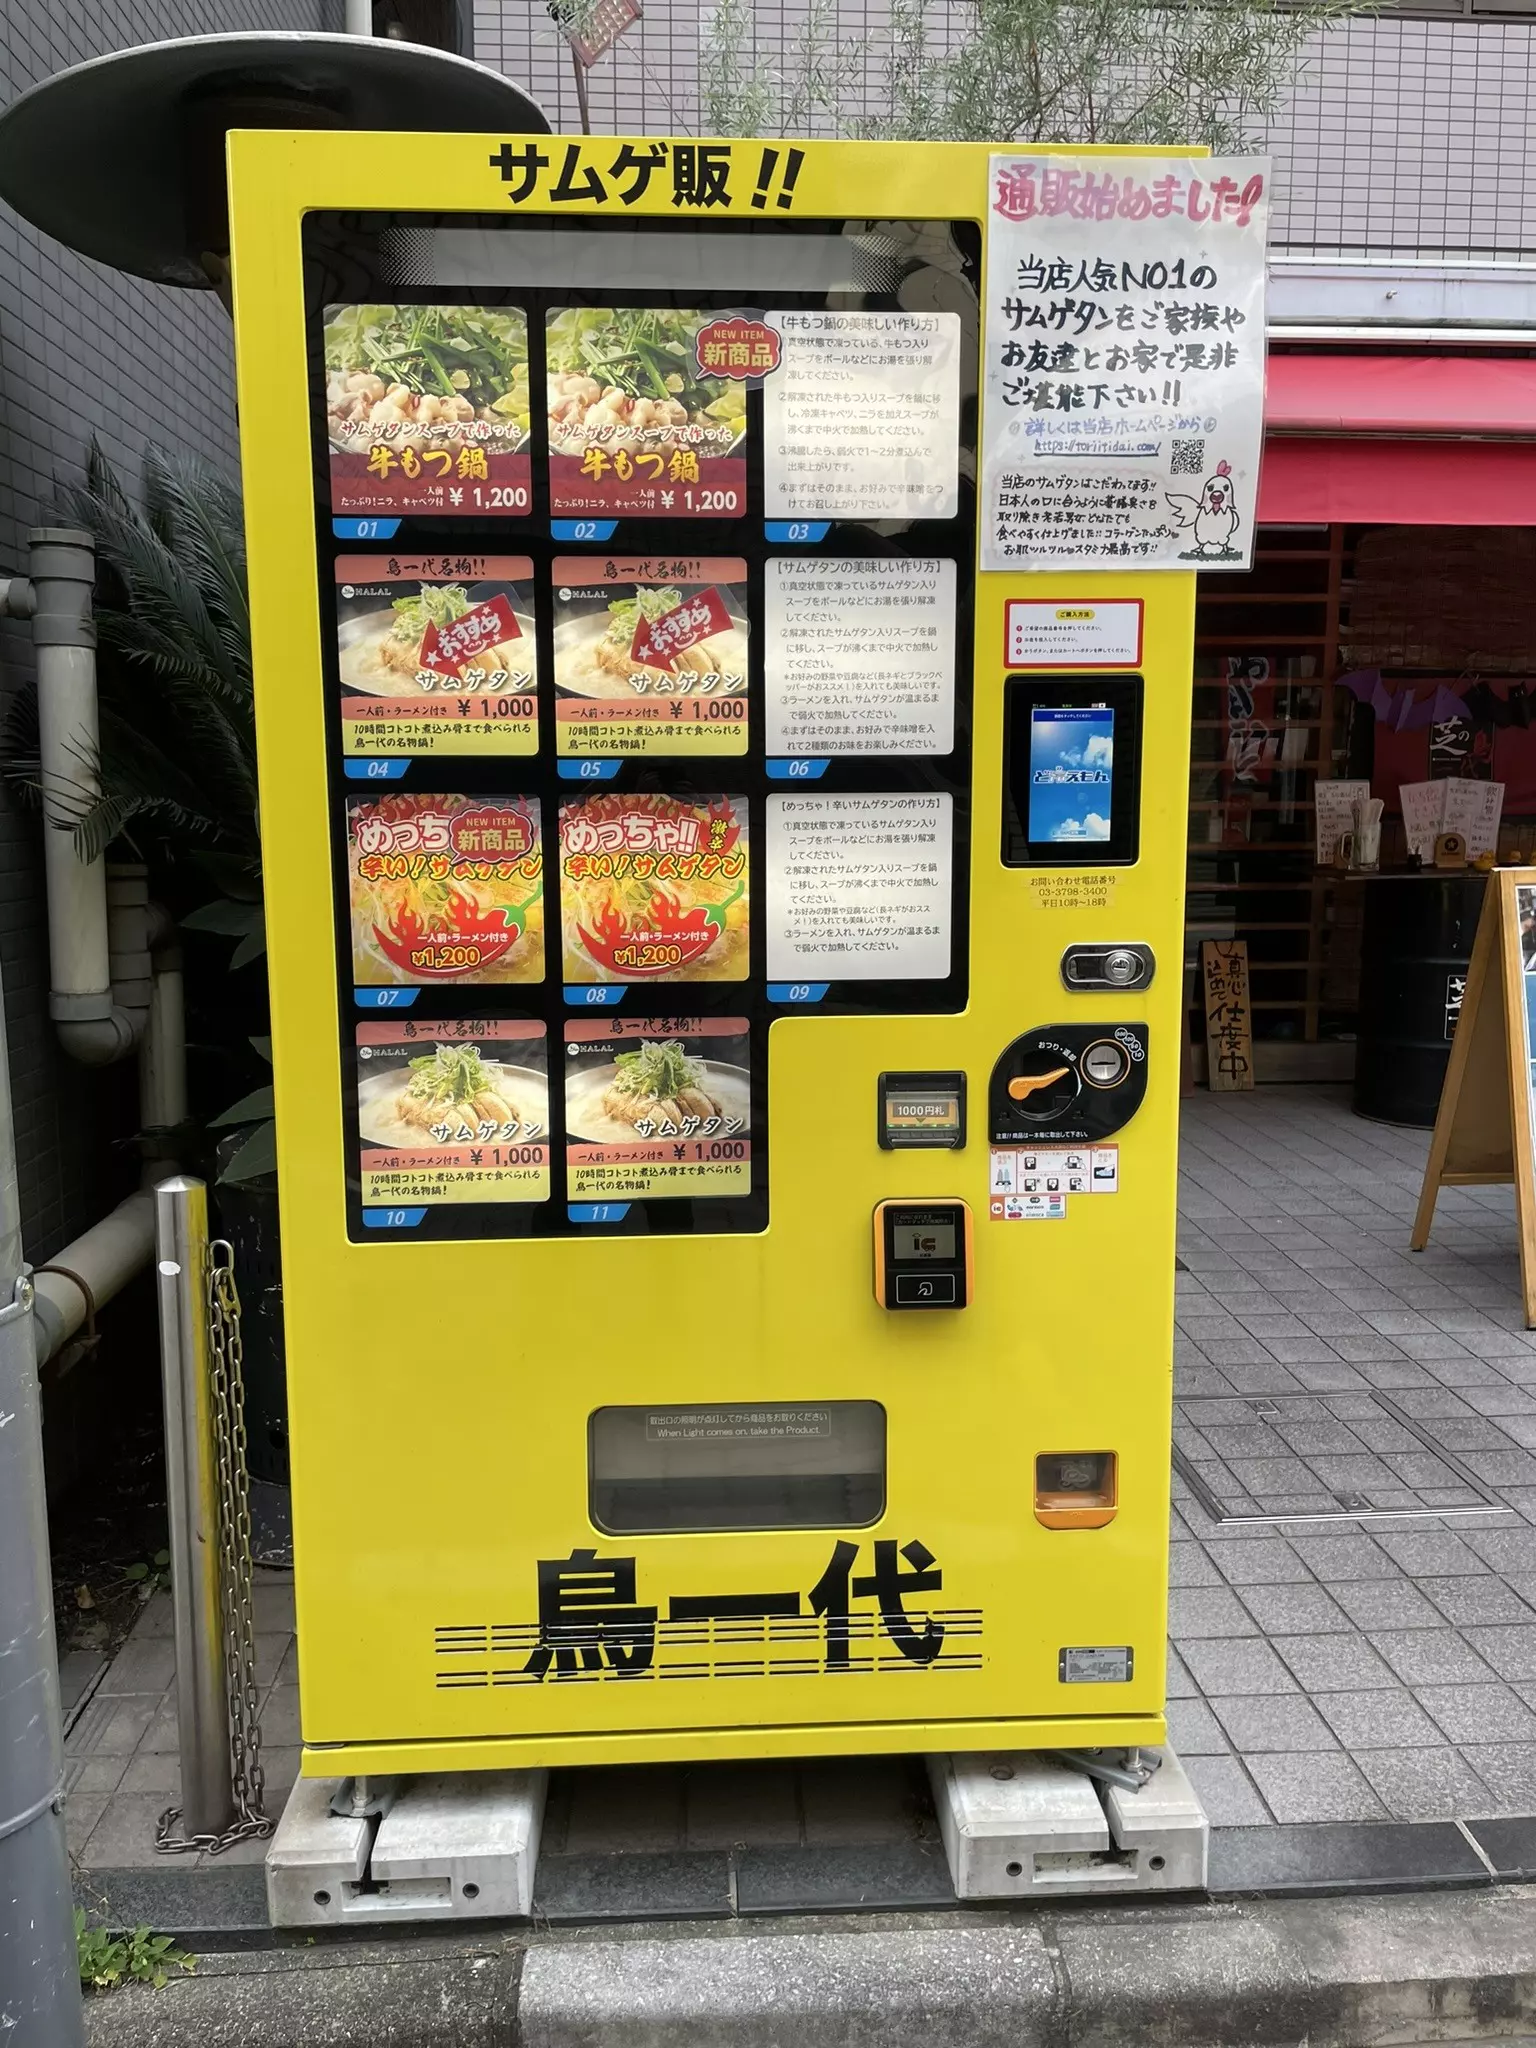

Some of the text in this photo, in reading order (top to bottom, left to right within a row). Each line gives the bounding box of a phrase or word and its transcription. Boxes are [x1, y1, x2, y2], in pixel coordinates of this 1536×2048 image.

[1017, 253, 1218, 294] 当店人気NO1の
[779, 316, 940, 332] 【牛もつ鍋の美味しい作り方】
[1000, 297, 1246, 335] サムゲタンをご家族や
[712, 330, 765, 340] NEW ITEM
[704, 342, 773, 367] 新商品
[1000, 339, 1239, 373] お友達とお家で是非
[340, 419, 522, 440] サムゲタンスープで作った
[556, 423, 733, 442] サムゲタンスープで作った
[367, 445, 488, 480] 牛もつ鍋
[580, 448, 700, 484] 牛もつ鍋
[473, 487, 527, 508] 1,200
[683, 490, 737, 511] 1,200
[357, 522, 379, 537] 01
[574, 523, 596, 538] 02
[788, 524, 809, 540] 03
[777, 560, 942, 574] 【サムゲタンの美味しい作り方】
[355, 587, 392, 596] HALAL
[571, 590, 608, 599] HALAL
[437, 607, 502, 659] おすすめ
[649, 601, 712, 651] おすすめ
[415, 669, 533, 693] サムゲタン
[629, 670, 744, 693] サムゲタン
[481, 699, 534, 718] 1,000
[692, 700, 745, 719] 1,000
[367, 761, 389, 777] 04
[580, 762, 602, 777] 05
[789, 761, 809, 776] 06
[781, 799, 941, 811] 【めっちゃ!辛いサムゲタンの作り方】
[466, 817, 516, 827] NEW ITEM
[457, 829, 526, 851] 新商品
[563, 812, 699, 854] めっちゃ!!
[789, 851, 845, 860] してください。
[564, 854, 745, 881] 辛い!サムゲタン
[1030, 875, 1116, 887] お問い合わせ電話番号
[790, 895, 837, 904] てください。
[1039, 887, 1107, 897] 03-3798-3400
[412, 945, 482, 968] ¥1,200
[614, 944, 682, 967] ¥1,200
[1221, 952, 1246, 997] 真心
[377, 990, 399, 1006] 07
[585, 988, 607, 1003] 08
[789, 985, 810, 1000] 09
[373, 1047, 408, 1056] HALAL
[580, 1044, 614, 1053] HALAL
[897, 1105, 945, 1118] 1000円札
[430, 1120, 543, 1143] サムゲタン
[633, 1116, 744, 1139] サムゲタン
[492, 1147, 543, 1166] 1,000
[694, 1142, 745, 1160] 1,000
[386, 1210, 406, 1225] 10
[591, 1206, 610, 1221] 11
[657, 1429, 682, 1438] When
[683, 1428, 704, 1438] Light
[750, 1427, 768, 1435] take
[770, 1427, 784, 1435] the
[522, 1540, 945, 1681] 鳥一代
